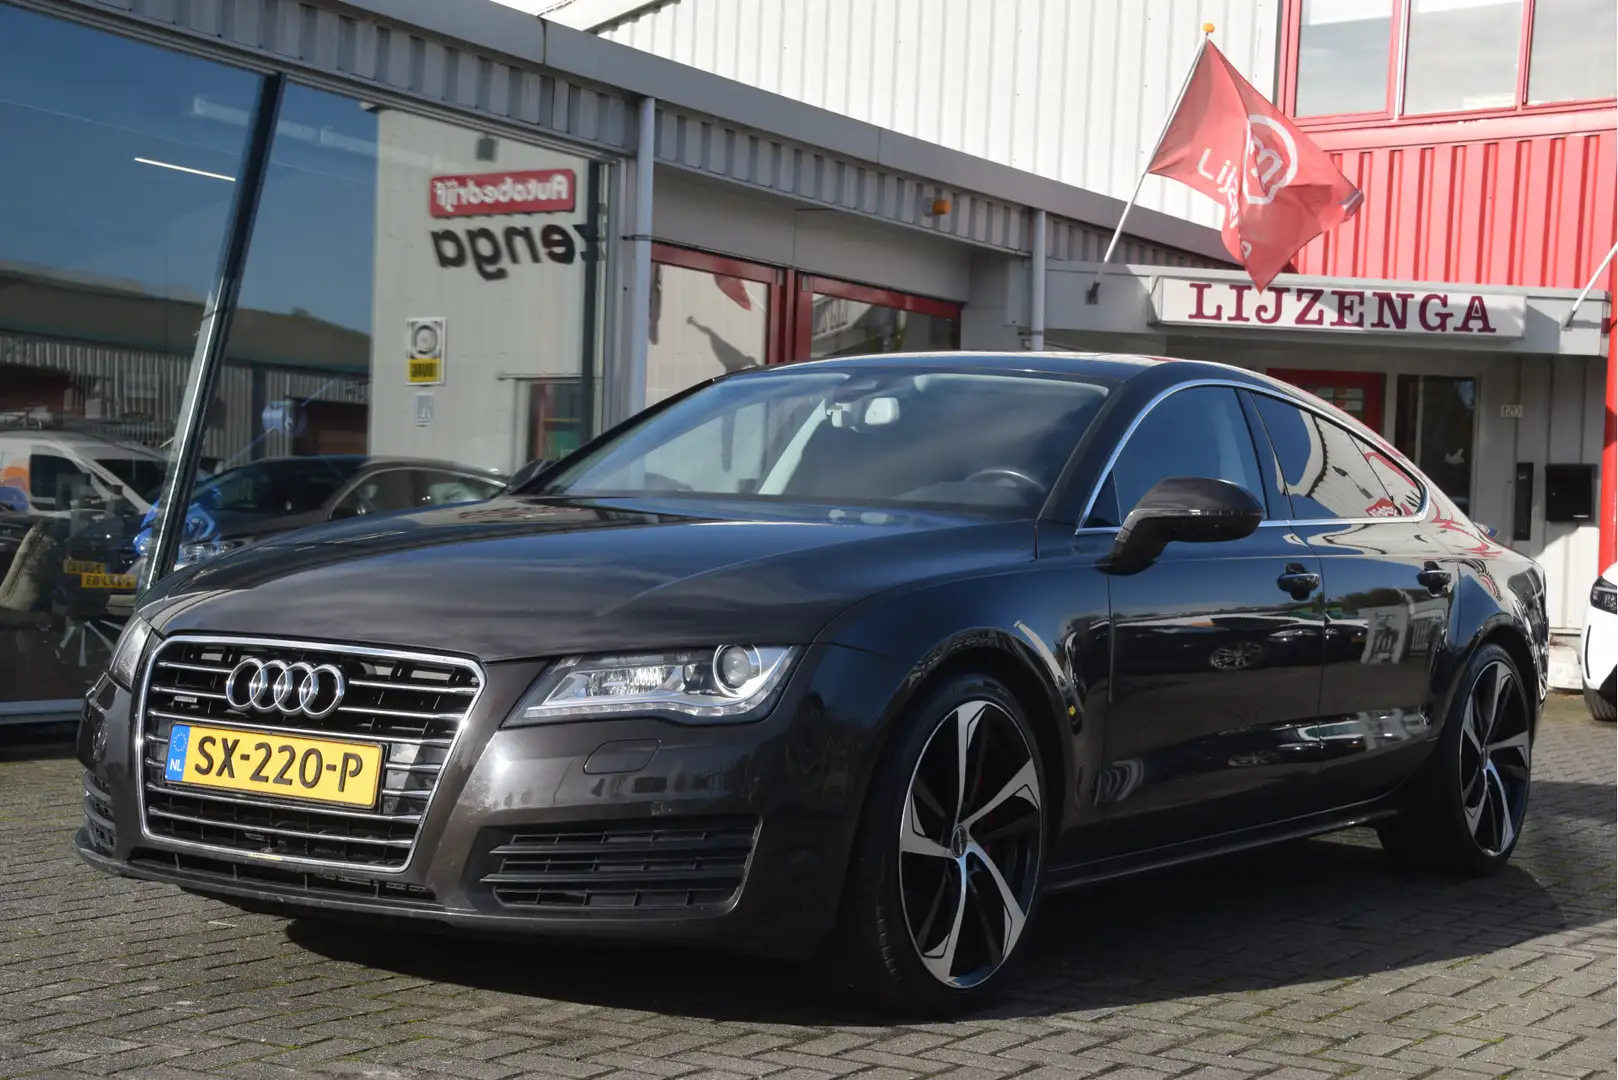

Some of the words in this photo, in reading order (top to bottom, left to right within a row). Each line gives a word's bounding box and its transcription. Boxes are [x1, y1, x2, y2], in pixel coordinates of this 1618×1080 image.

[1188, 283, 1496, 333] LIJZENGA
[169, 759, 183, 772] NL
[194, 735, 363, 793] SX-220-P
